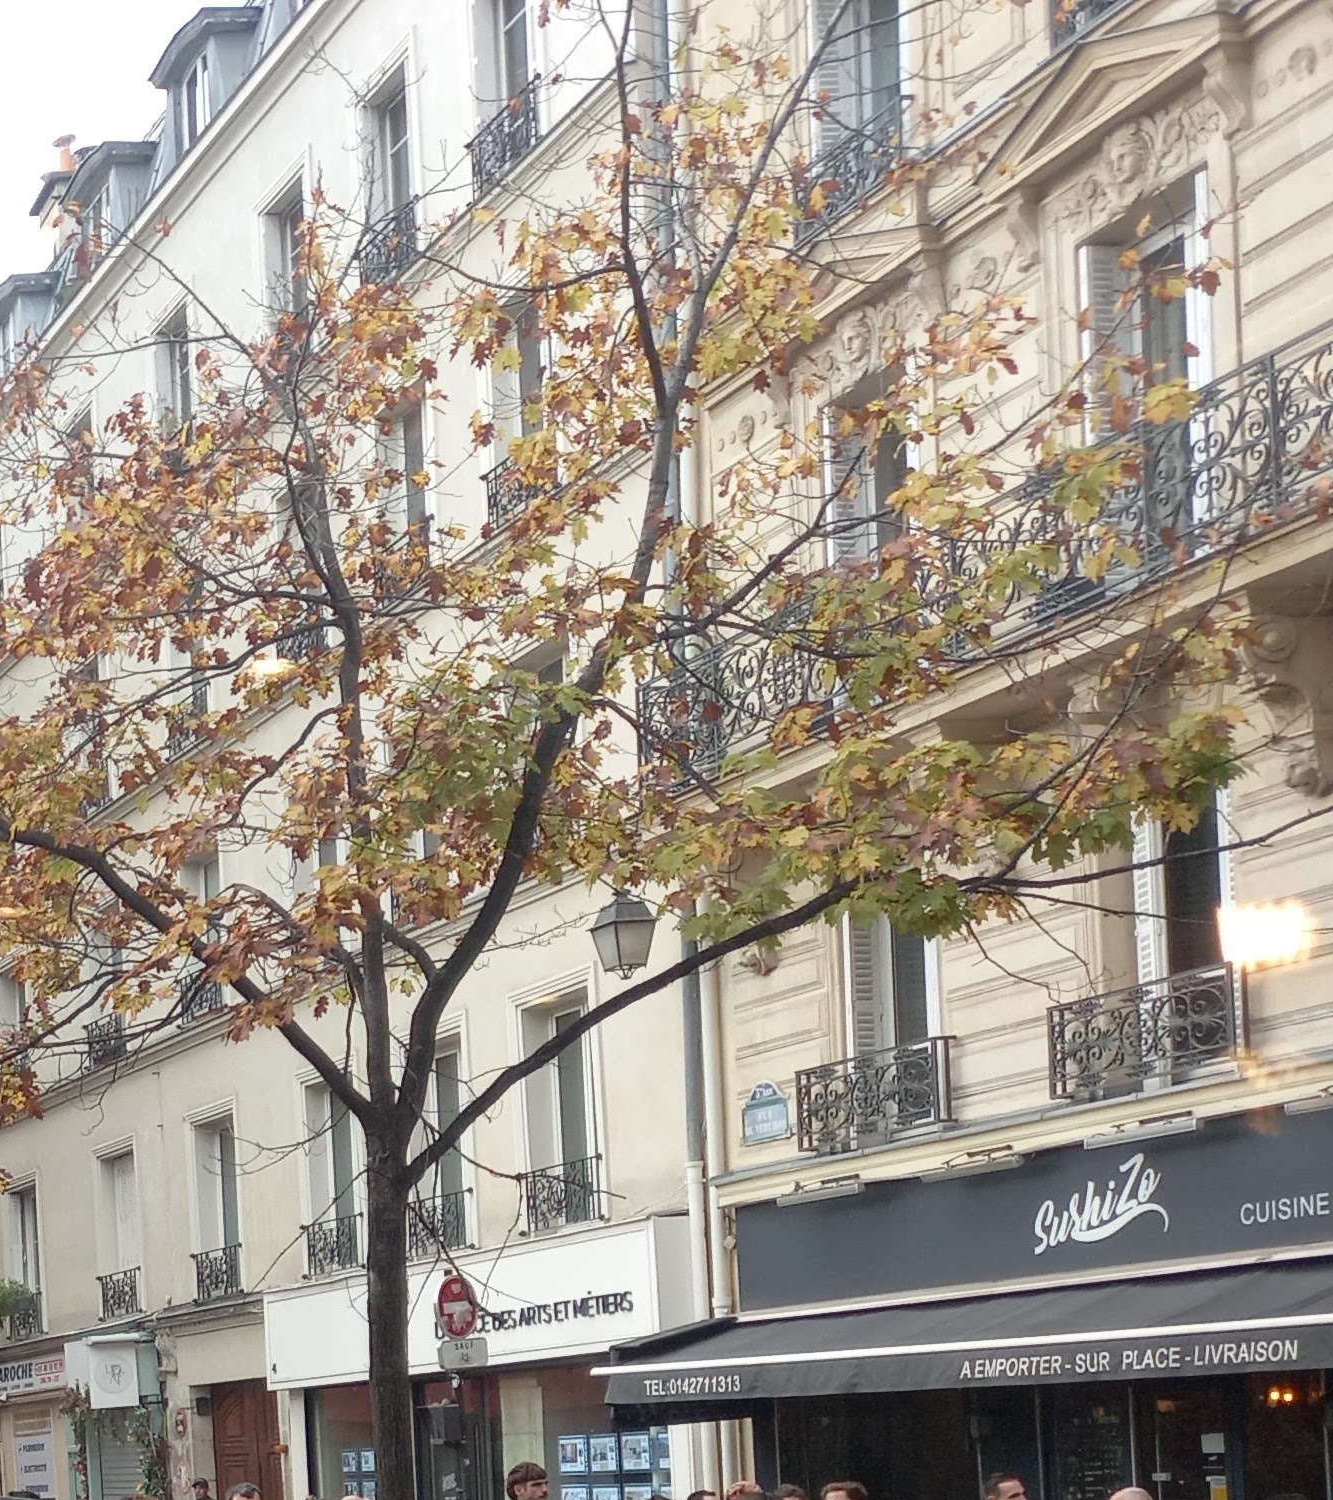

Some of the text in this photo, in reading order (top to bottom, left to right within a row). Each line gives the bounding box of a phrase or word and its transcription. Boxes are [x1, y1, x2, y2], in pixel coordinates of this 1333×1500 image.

[1240, 1192, 1331, 1225] CUISINE
[491, 1310, 518, 1333] DES
[519, 1304, 553, 1328] ARTS
[554, 1300, 572, 1322] ET
[573, 1291, 634, 1319] MÉTIERS
[454, 1341, 474, 1350] SAUF
[960, 1360, 971, 1379] A
[974, 1355, 1062, 1378] EMPORTER
[1075, 1352, 1111, 1374] SUR
[1122, 1347, 1181, 1371] PLACE
[1194, 1339, 1299, 1366] LIVRAISON
